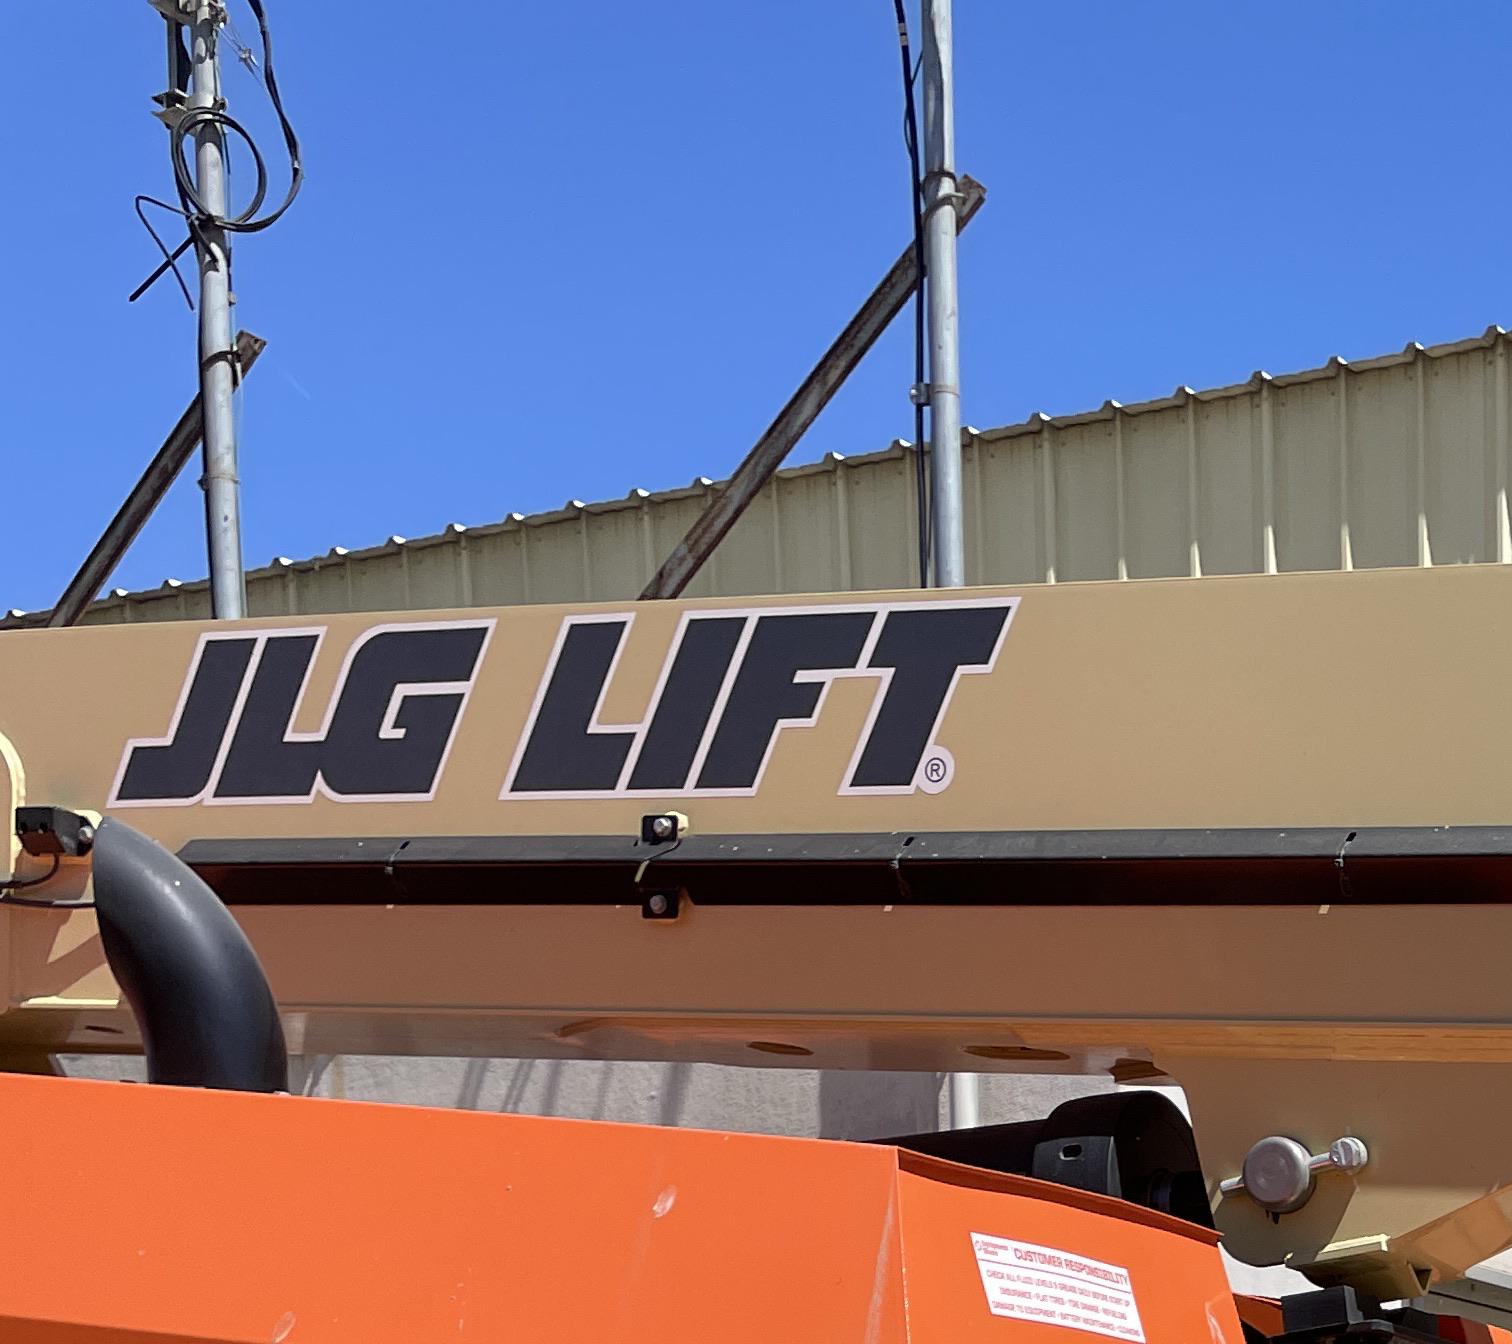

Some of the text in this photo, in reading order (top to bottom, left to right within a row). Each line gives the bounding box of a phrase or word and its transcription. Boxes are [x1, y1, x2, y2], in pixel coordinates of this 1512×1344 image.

[112, 602, 1014, 803] JLG LIFT
[1014, 1248, 1063, 1268] CUSTOMER
[1065, 1258, 1128, 1286] RESPONSIBILITY
